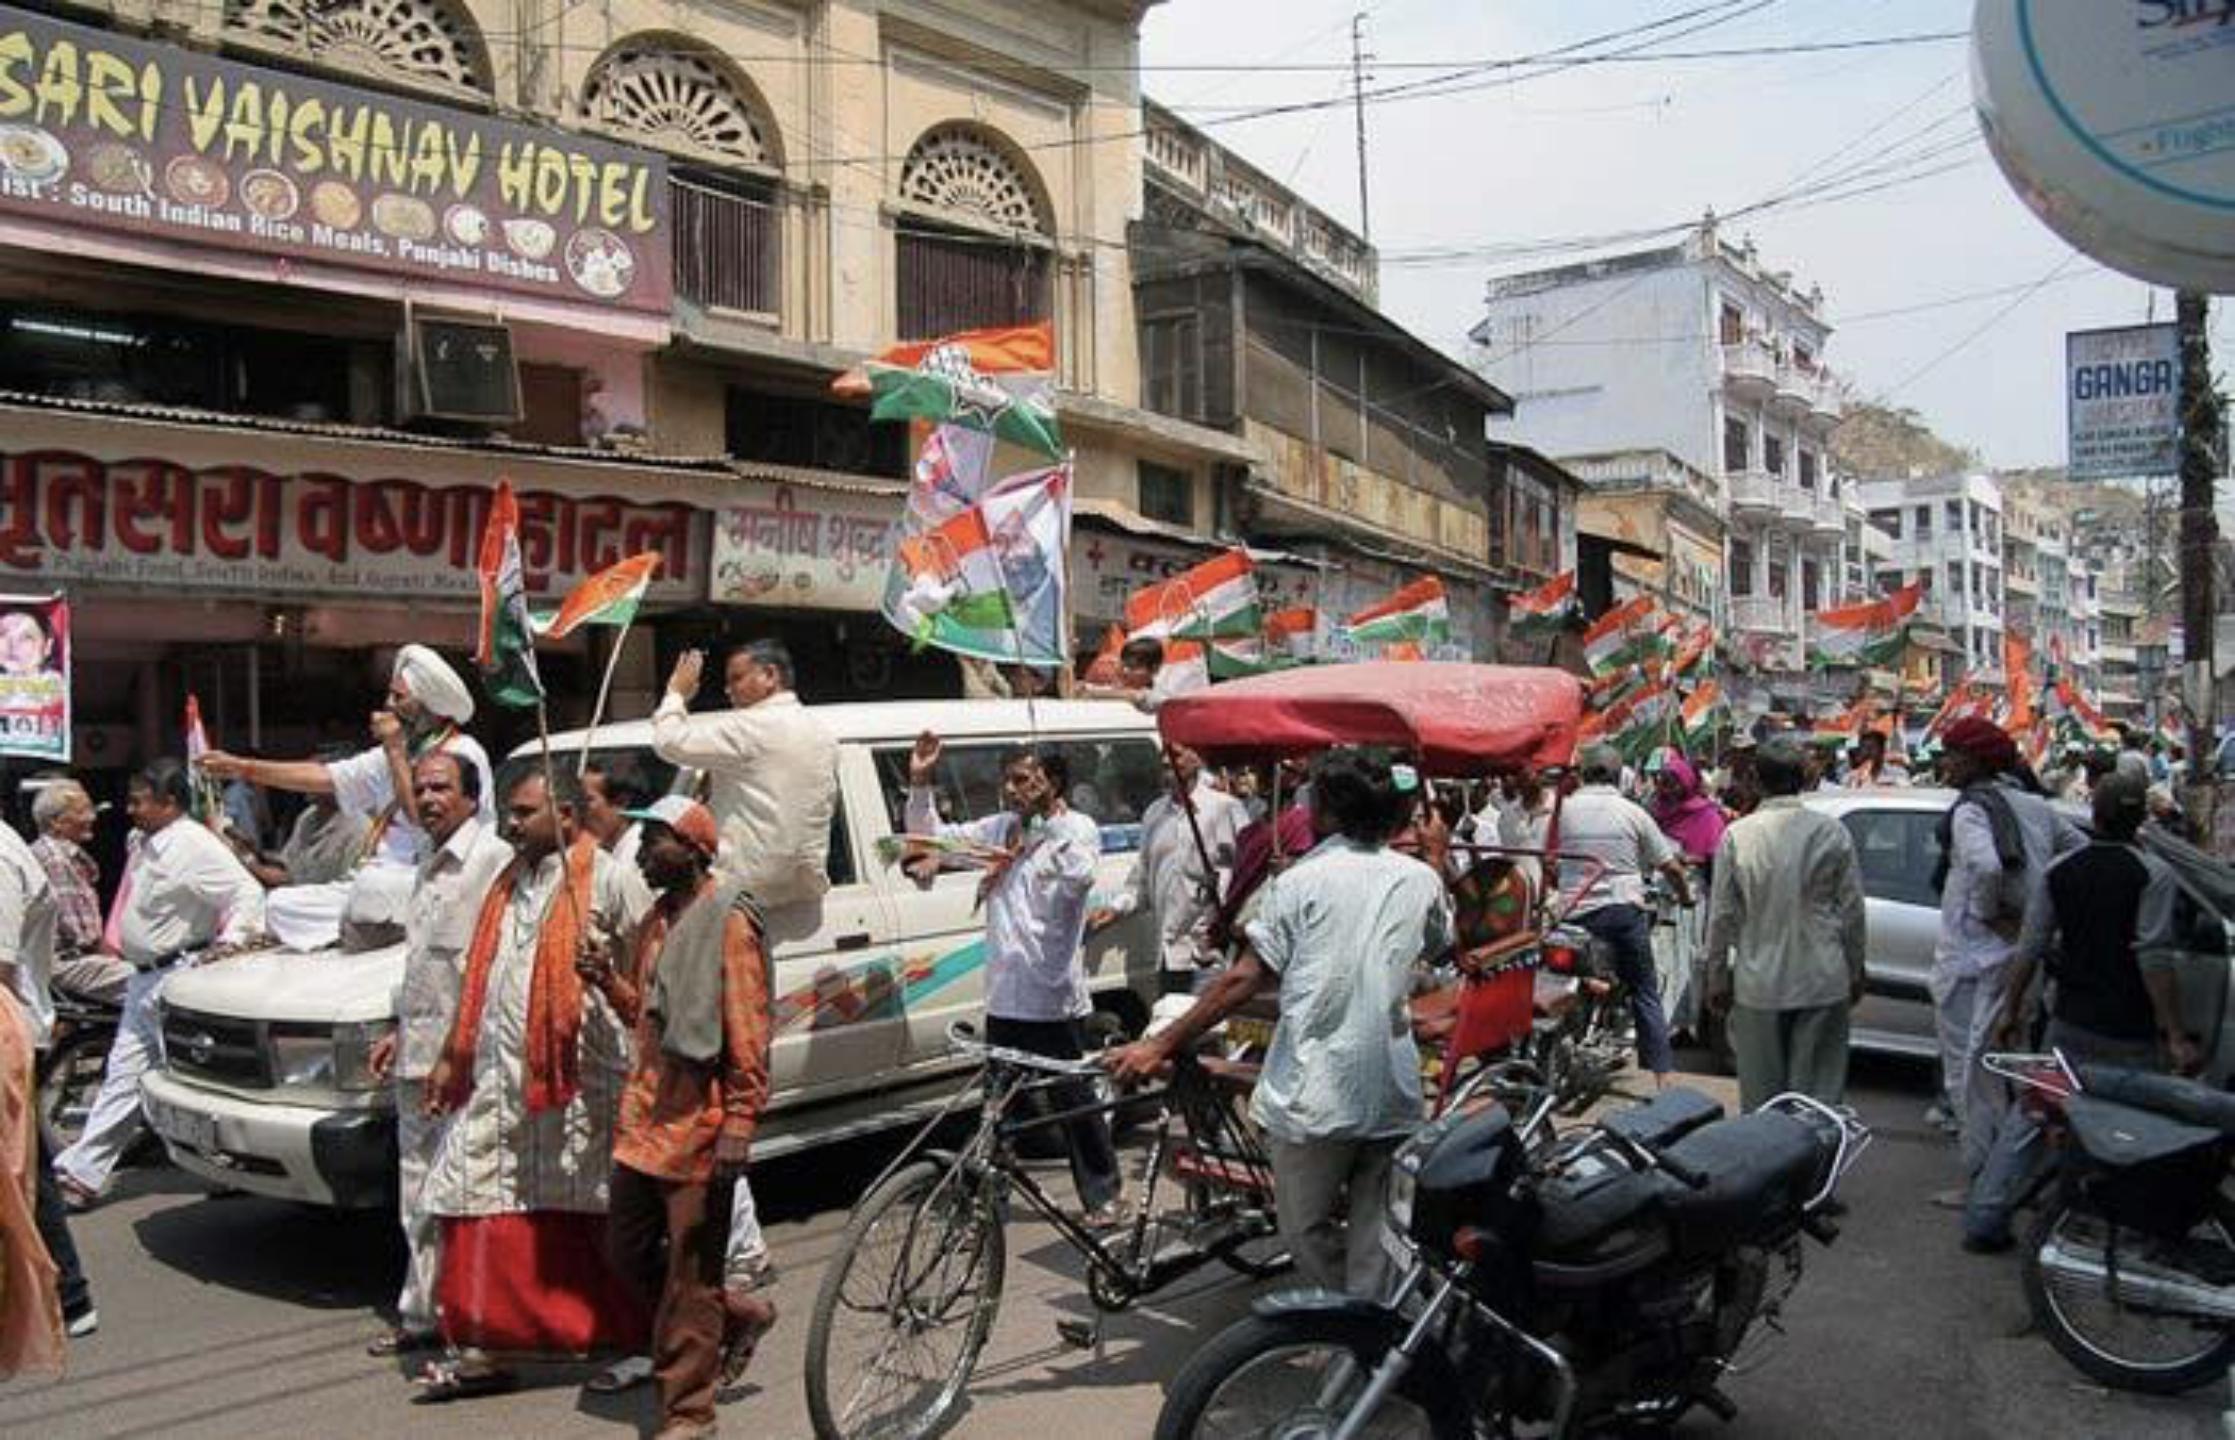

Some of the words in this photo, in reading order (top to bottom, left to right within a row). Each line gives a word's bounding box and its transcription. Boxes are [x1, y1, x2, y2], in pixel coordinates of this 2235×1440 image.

[0, 31, 163, 141] SARI
[186, 74, 481, 198] VAISHNAV
[500, 139, 656, 233] HOTEL
[70, 183, 150, 217] South
[159, 199, 241, 231] Indian
[251, 213, 304, 240] Rice
[399, 239, 480, 268] Punjabi
[487, 250, 560, 282] Dishes
[2074, 359, 2172, 400] GANGA
